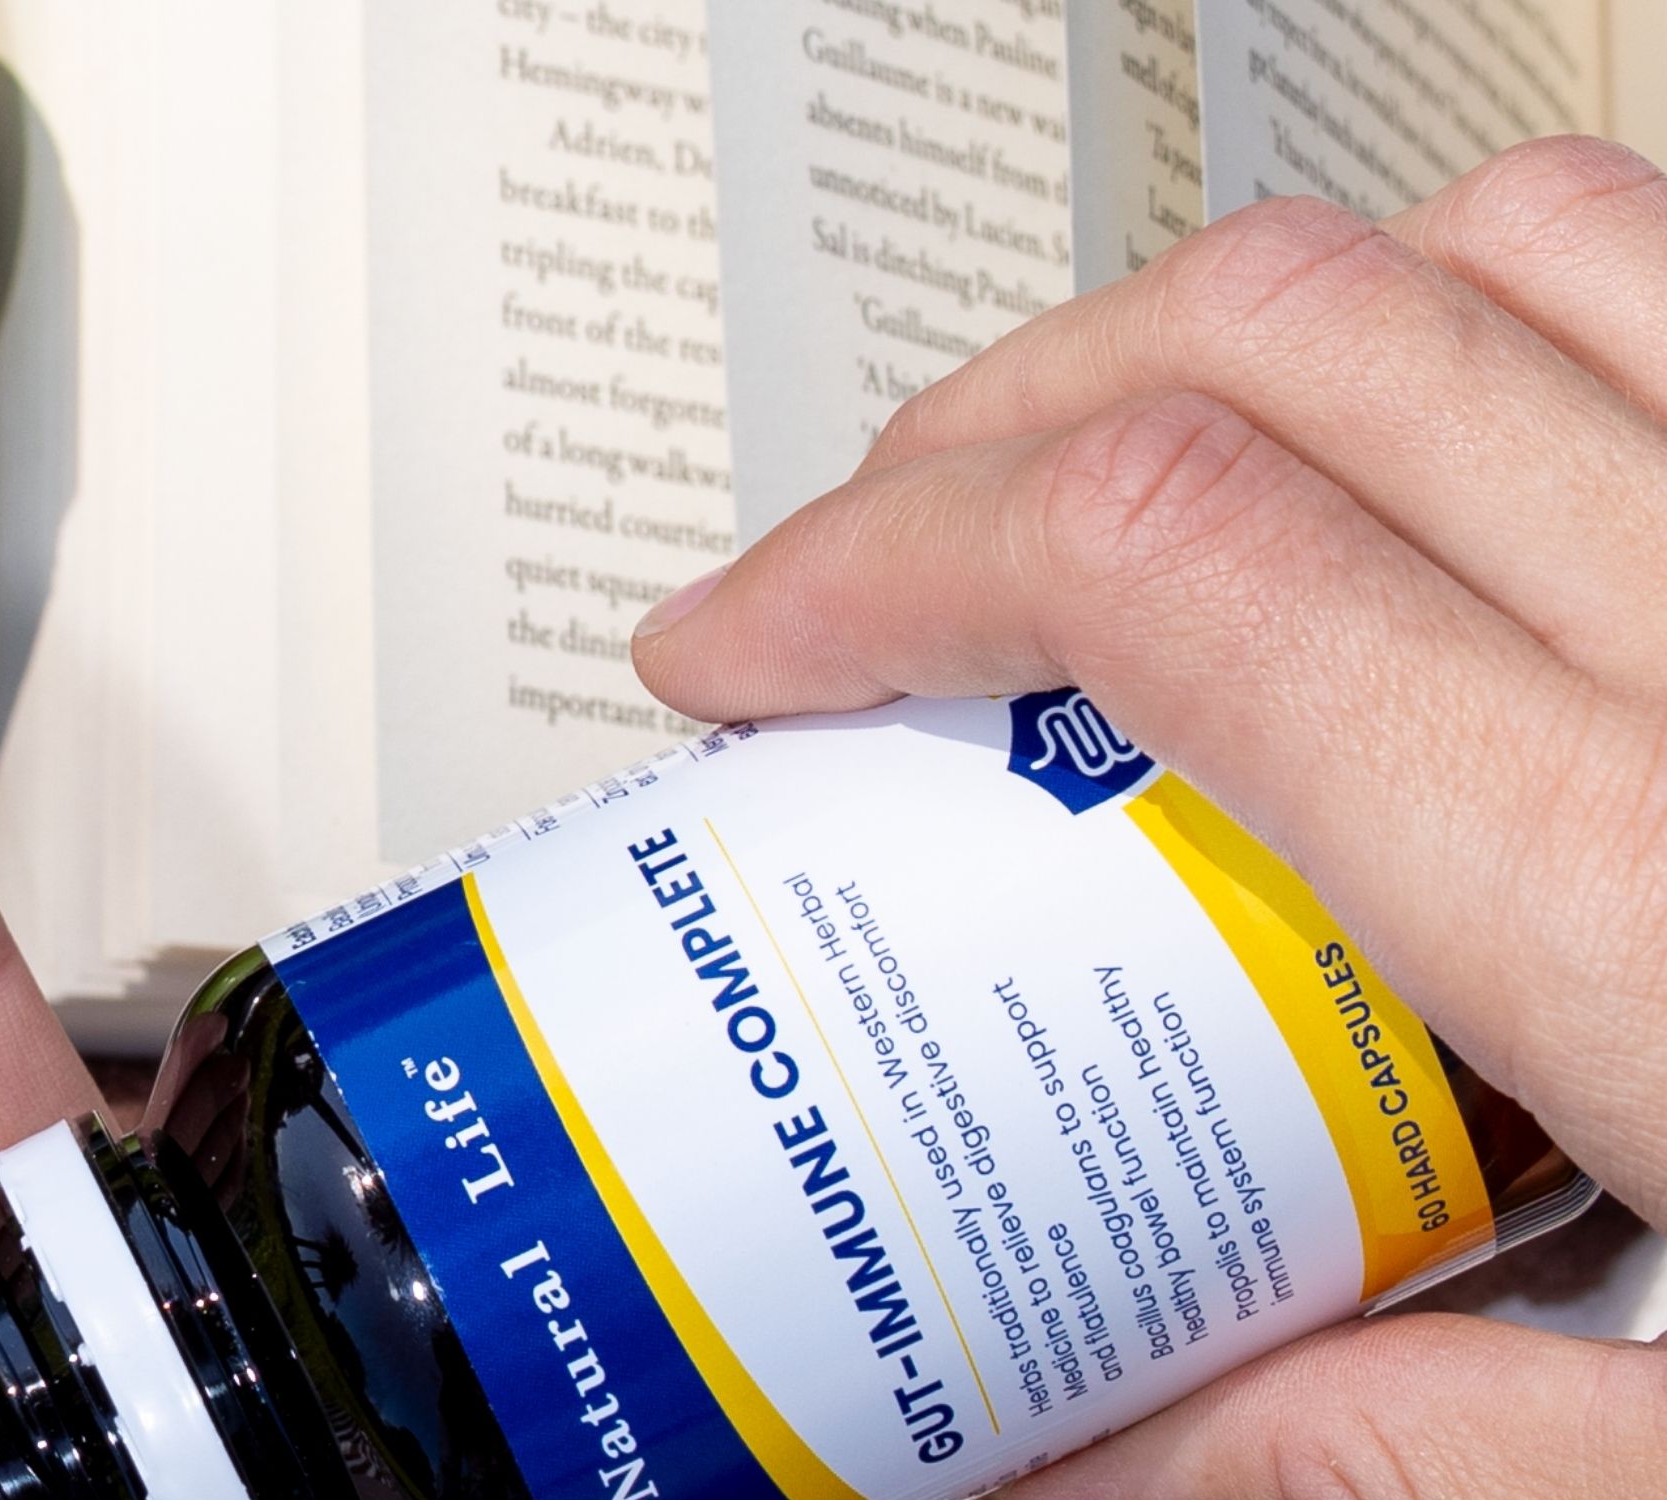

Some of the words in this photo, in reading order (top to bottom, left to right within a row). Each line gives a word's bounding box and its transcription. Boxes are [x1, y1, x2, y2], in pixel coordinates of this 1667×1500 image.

[585, 0, 632, 42] the
[906, 3, 969, 49] when
[974, 17, 1060, 82] Pauline
[498, 43, 676, 121] Hemingway
[801, 24, 930, 99] Guillaume
[934, 69, 955, 107] is
[959, 88, 971, 113] a
[975, 91, 1023, 127] new
[898, 115, 989, 179] himself
[991, 148, 1050, 200] from
[498, 165, 638, 228] breakfast
[647, 205, 682, 234] to
[808, 163, 929, 222] unnoticed
[931, 185, 959, 242] by
[500, 237, 616, 296] tripling
[620, 252, 668, 294] the
[851, 229, 870, 264] is
[874, 235, 974, 310] ditching
[502, 289, 576, 341] front
[584, 308, 623, 346] of
[623, 317, 670, 358] the
[502, 356, 601, 406] almost
[503, 419, 540, 456] of
[539, 438, 554, 460] a
[559, 426, 624, 484] long
[504, 479, 614, 534] hurried
[505, 553, 581, 595] quiet
[507, 606, 554, 651] the
[507, 673, 658, 731] important
[782, 871, 847, 962] Herbal
[834, 879, 928, 1034] discomfort
[626, 826, 800, 1100] COMPLETE
[837, 962, 909, 1089] Western
[991, 976, 1065, 1097] support
[1092, 965, 1162, 1080] healthy
[1152, 990, 1221, 1116] function
[1314, 941, 1408, 1116] CAPSULES
[900, 1089, 927, 1123] in
[919, 1039, 996, 1176] digestive
[1054, 1101, 1081, 1136] to
[1080, 1063, 1148, 1186] function
[1150, 1080, 1219, 1208] maintain
[909, 1124, 963, 1201] used
[1209, 1117, 1266, 1215] system
[1391, 1119, 1441, 1201] HARD
[986, 1180, 1040, 1275] relieve
[1070, 1138, 1145, 1280] coagulans
[1129, 1186, 1182, 1269] bowel
[1205, 1210, 1230, 1240] to
[1416, 1198, 1450, 1233] 60
[772, 1104, 964, 1464] GUT-IMMUNE
[951, 1206, 1032, 1360] traditionally
[1027, 1276, 1052, 1307] to
[1046, 1222, 1110, 1345] flatulence
[1213, 1239, 1259, 1321] Propolis
[1250, 1216, 1294, 1303] immune
[1131, 1282, 1174, 1360] Bacillus
[1166, 1267, 1209, 1346] healthy
[1017, 1358, 1053, 1417] Herbs
[1039, 1306, 1088, 1401] Medicine
[1088, 1341, 1123, 1382] and
